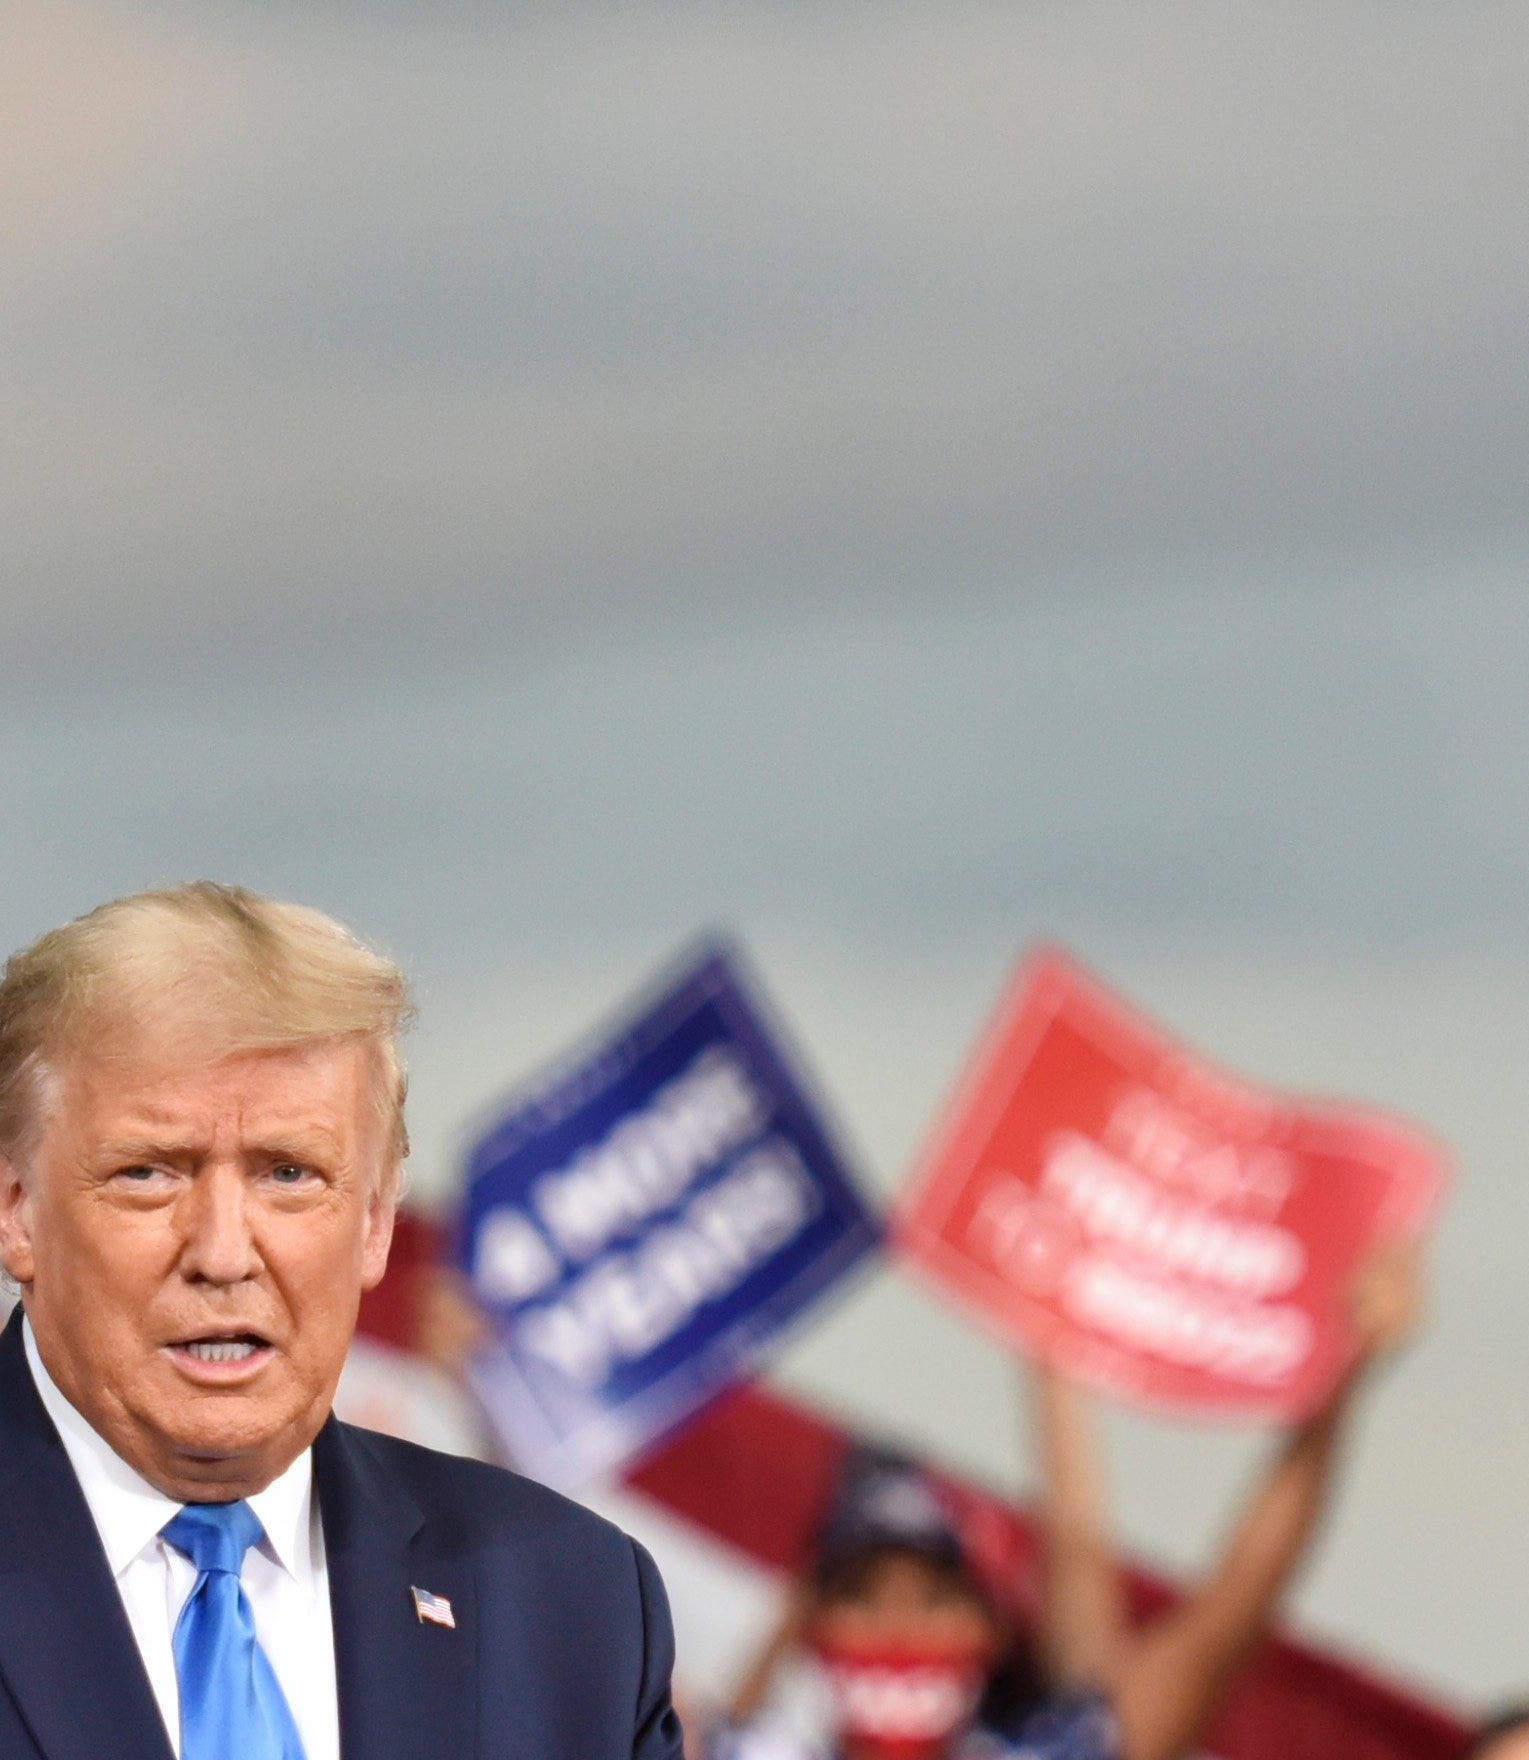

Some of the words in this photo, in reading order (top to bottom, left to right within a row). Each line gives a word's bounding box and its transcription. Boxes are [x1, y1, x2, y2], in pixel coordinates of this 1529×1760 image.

[480, 1208, 558, 1300] 4
[534, 1046, 756, 1260] MORE
[518, 1140, 817, 1382] YEARS
